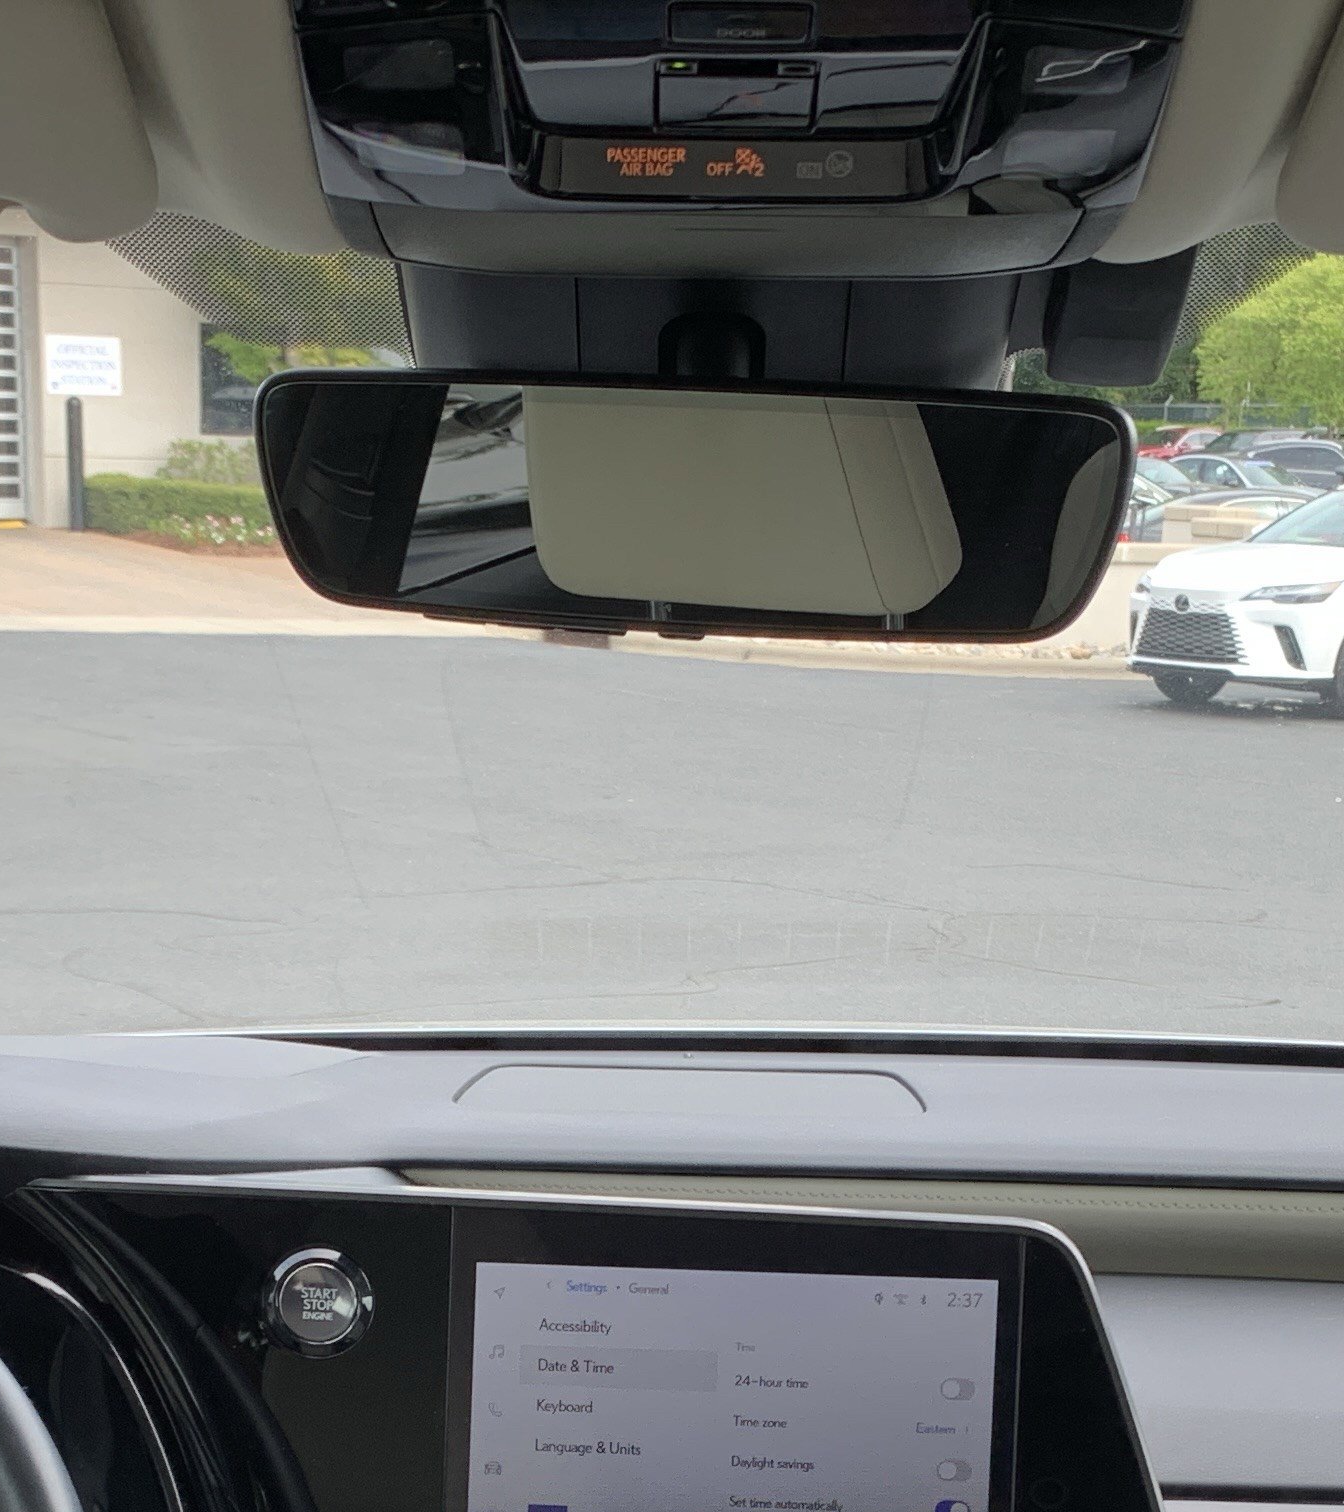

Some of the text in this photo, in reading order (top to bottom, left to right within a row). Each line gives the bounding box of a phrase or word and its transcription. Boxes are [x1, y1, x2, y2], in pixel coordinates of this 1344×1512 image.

[607, 147, 687, 163] PASSENGER
[620, 162, 643, 176] AIR
[646, 162, 674, 177] BAG
[706, 162, 733, 176] OFF
[301, 1287, 339, 1300] START
[566, 1280, 670, 1296] Settings General
[303, 1299, 335, 1311] STOP
[947, 1292, 983, 1309] 2:37
[302, 1311, 334, 1321] ENGINE
[539, 1318, 612, 1336] Accessibility
[538, 1357, 615, 1375] Date & Time
[734, 1374, 809, 1389] 24-hour time
[537, 1399, 593, 1415] Keyboard
[734, 1415, 760, 1429] Time
[762, 1418, 788, 1430] zone
[535, 1439, 641, 1457] Language & Units
[731, 1456, 815, 1473] Daylight savings
[729, 1496, 748, 1509] Set
[750, 1497, 773, 1510] time
